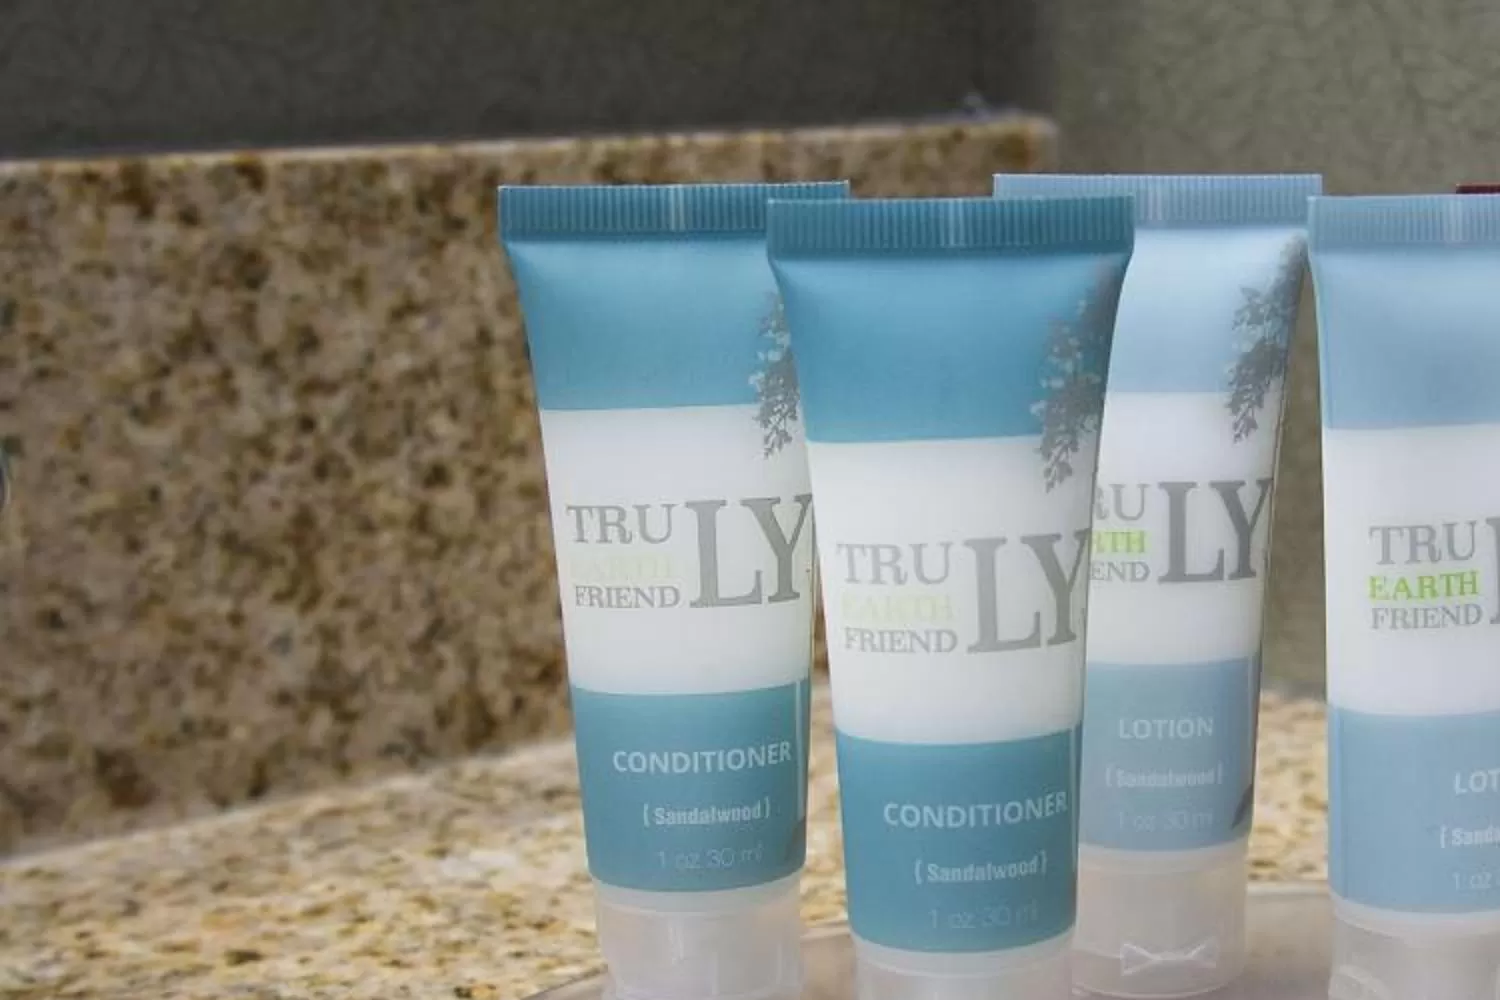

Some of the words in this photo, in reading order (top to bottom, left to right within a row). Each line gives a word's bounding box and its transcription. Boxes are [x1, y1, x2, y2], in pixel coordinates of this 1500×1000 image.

[575, 584, 681, 608] FRIEND
[1368, 570, 1480, 600] EARTH
[1371, 603, 1484, 629] FRIEND
[843, 626, 959, 654] FRIEND
[1118, 716, 1213, 740] LOTION
[613, 741, 791, 774] CONDITIONER
[883, 791, 1067, 828] CONDITIONER
